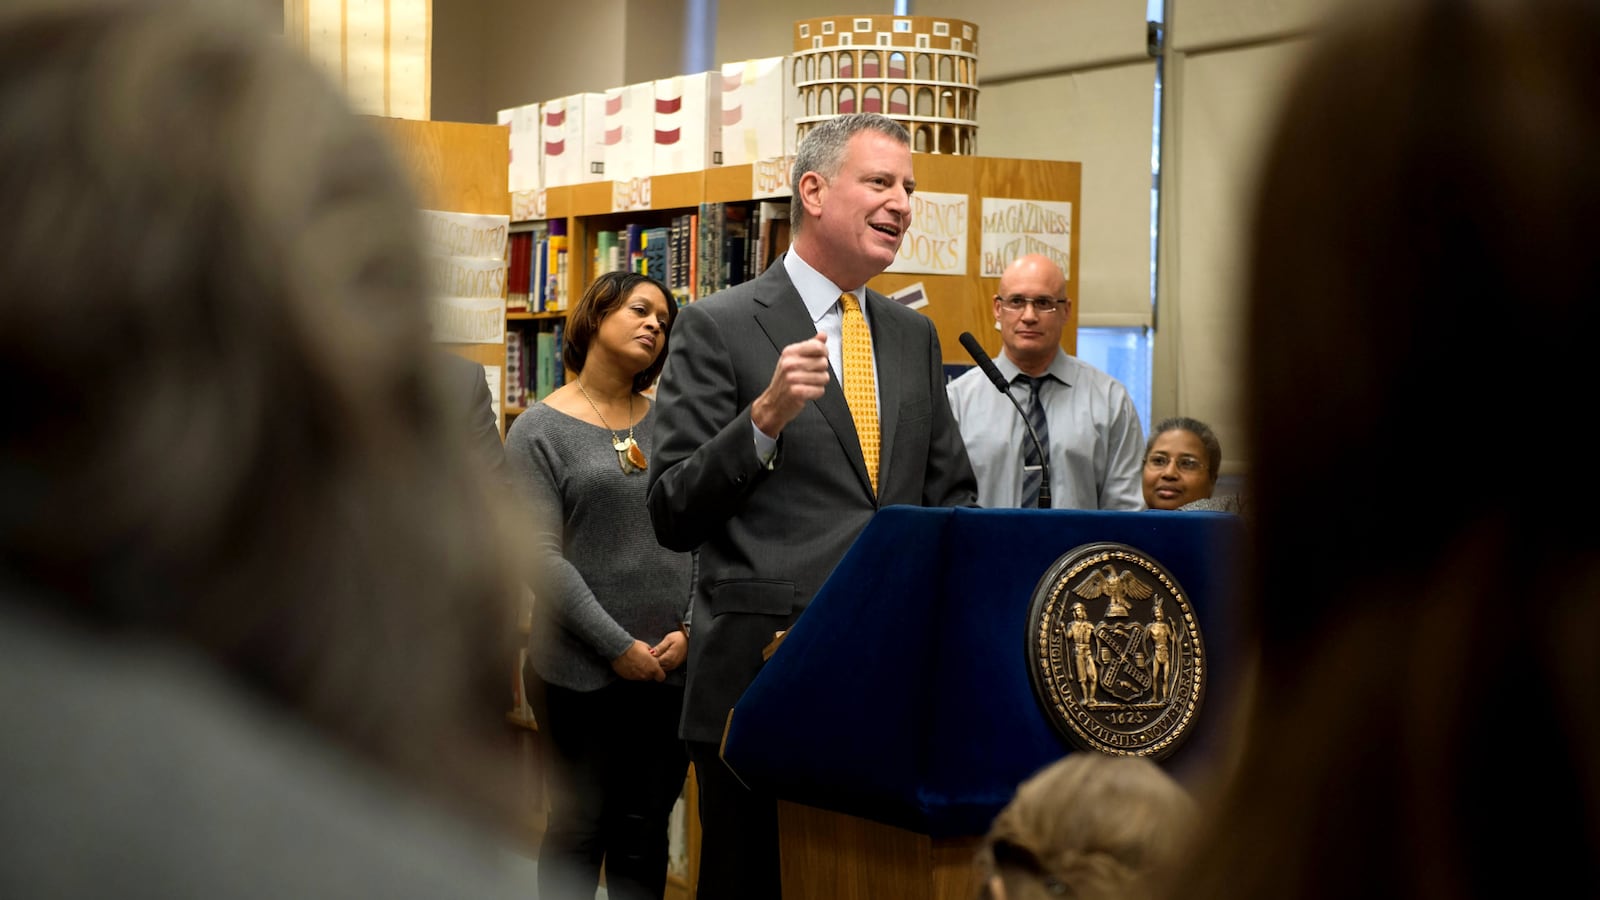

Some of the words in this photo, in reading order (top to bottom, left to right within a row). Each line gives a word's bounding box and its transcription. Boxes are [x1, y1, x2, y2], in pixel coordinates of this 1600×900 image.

[900, 230, 959, 271] OOKS
[1077, 711, 1138, 746] CIVITATIS
[1111, 711, 1143, 724] 1625
